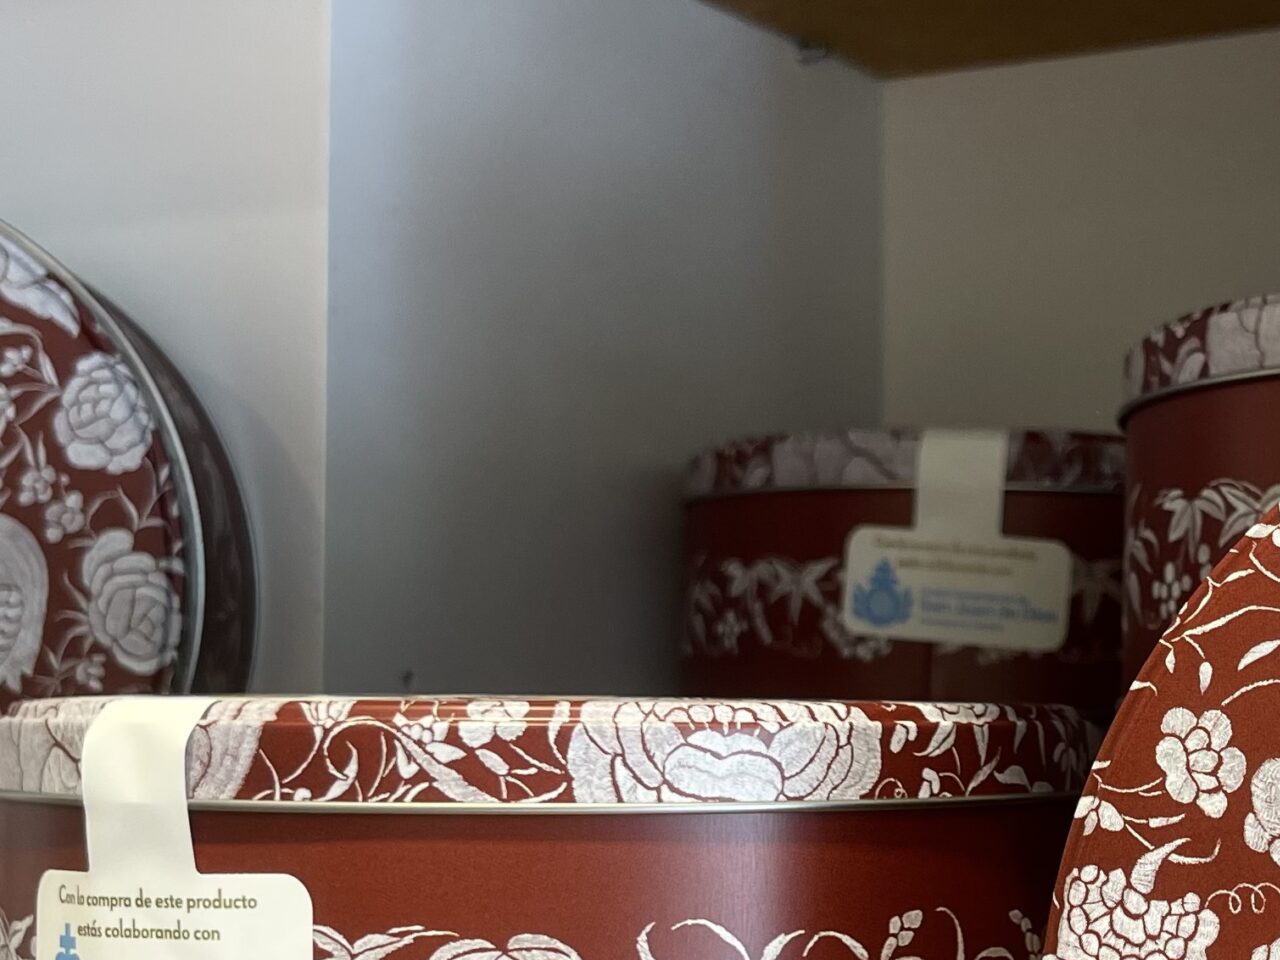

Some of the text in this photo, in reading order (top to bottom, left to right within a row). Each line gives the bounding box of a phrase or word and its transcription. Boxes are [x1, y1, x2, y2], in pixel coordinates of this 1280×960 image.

[59, 884, 76, 904] Con
[87, 895, 131, 911] compra
[135, 887, 152, 908] de
[155, 895, 183, 909] este
[187, 889, 257, 912] producto
[77, 918, 221, 941] estás colaborando con
